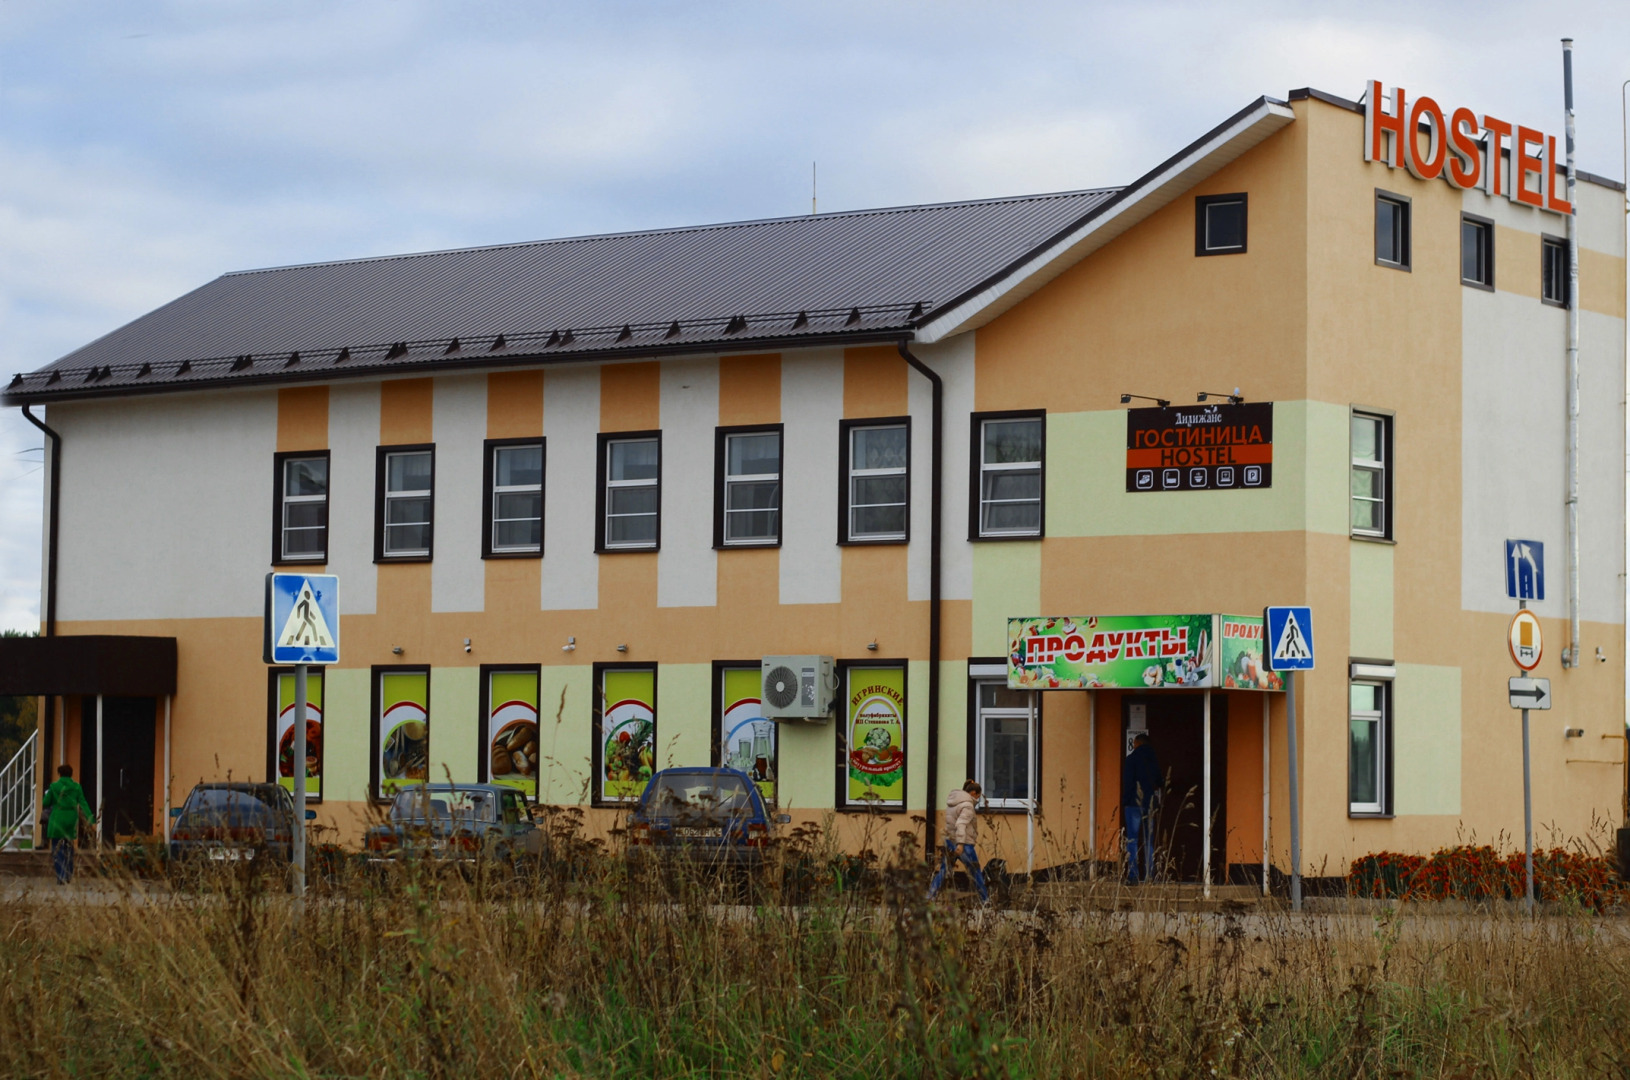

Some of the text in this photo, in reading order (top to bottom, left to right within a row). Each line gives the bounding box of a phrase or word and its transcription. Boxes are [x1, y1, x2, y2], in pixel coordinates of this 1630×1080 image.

[1365, 80, 1572, 215] HOSTEL
[1135, 425, 1263, 447] ГОСТИНИЦА
[1161, 446, 1236, 466] HOSTEL
[1026, 628, 1189, 665] ПРОДУКТЫ
